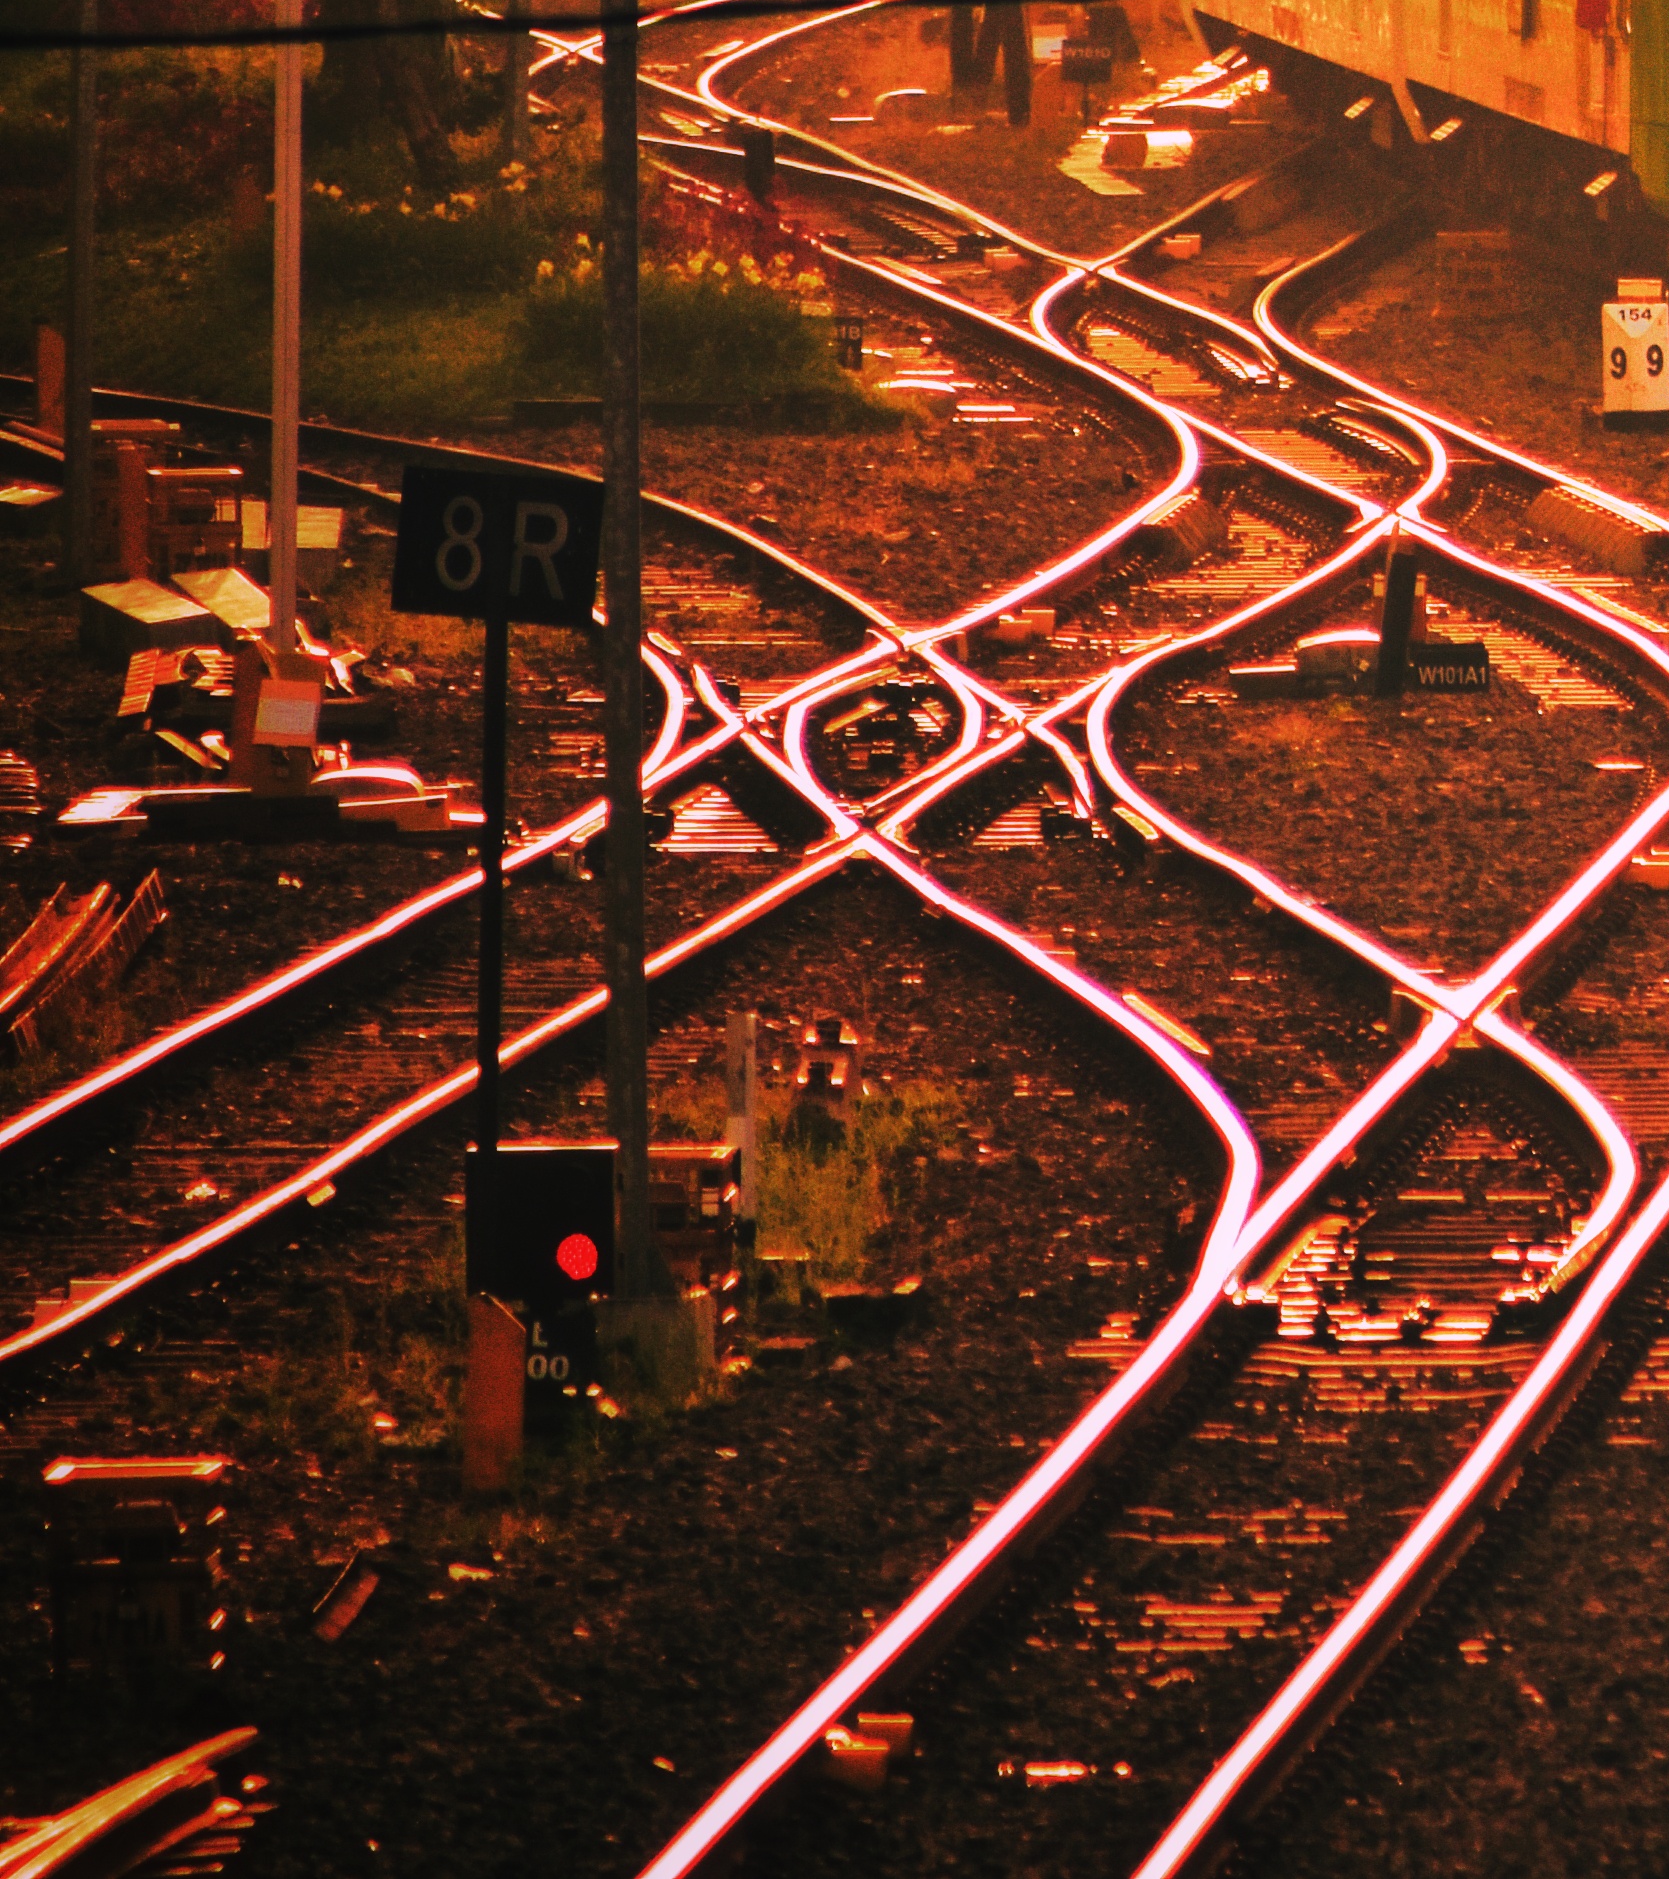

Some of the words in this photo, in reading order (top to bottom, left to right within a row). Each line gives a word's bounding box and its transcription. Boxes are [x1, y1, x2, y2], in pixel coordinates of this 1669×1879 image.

[1619, 308, 1652, 321] 154
[1610, 347, 1627, 380] 9
[1646, 344, 1664, 377] 9
[1418, 665, 1486, 685] W101A1
